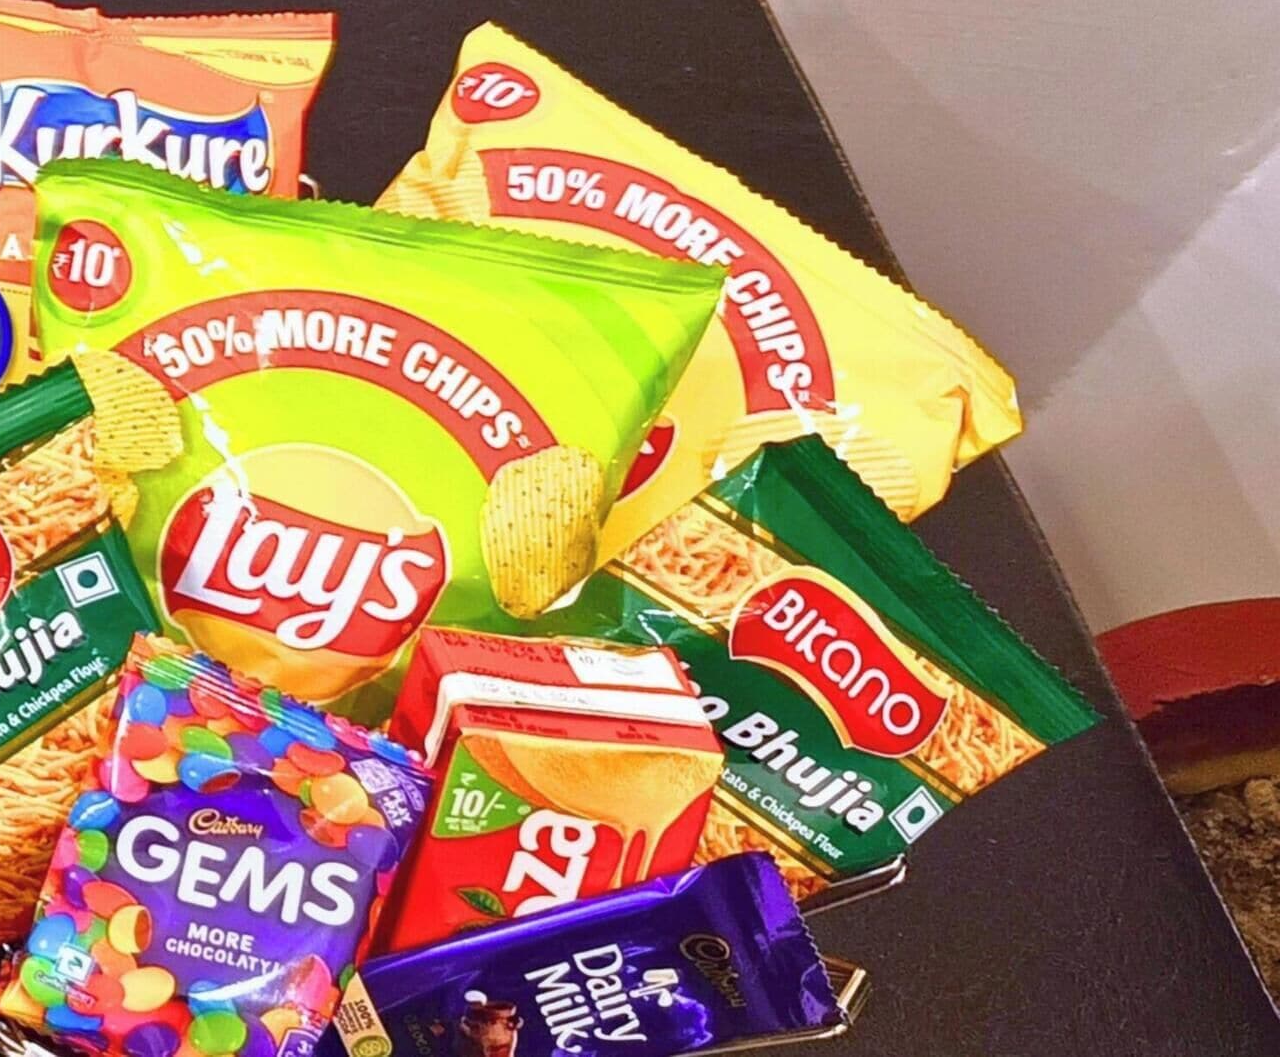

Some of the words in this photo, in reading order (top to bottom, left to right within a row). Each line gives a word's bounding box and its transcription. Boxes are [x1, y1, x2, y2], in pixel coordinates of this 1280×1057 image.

[507, 164, 607, 210] 50%
[615, 182, 745, 268] MORE
[151, 324, 255, 378] 50%
[260, 309, 399, 367] MORE
[173, 483, 435, 650] Lay's
[8, 712, 23, 729] &
[19, 676, 75, 723] Chickpea
[70, 656, 108, 691] Flour
[722, 712, 886, 834] Bhujia
[187, 808, 264, 840] Cadbury
[748, 785, 761, 802] &
[760, 794, 814, 843] Chickpea
[812, 831, 845, 861] Flour
[116, 815, 360, 927] GEMS
[187, 921, 255, 953] MORE
[523, 961, 595, 1054] Milk
[572, 943, 648, 1042] Dairy
